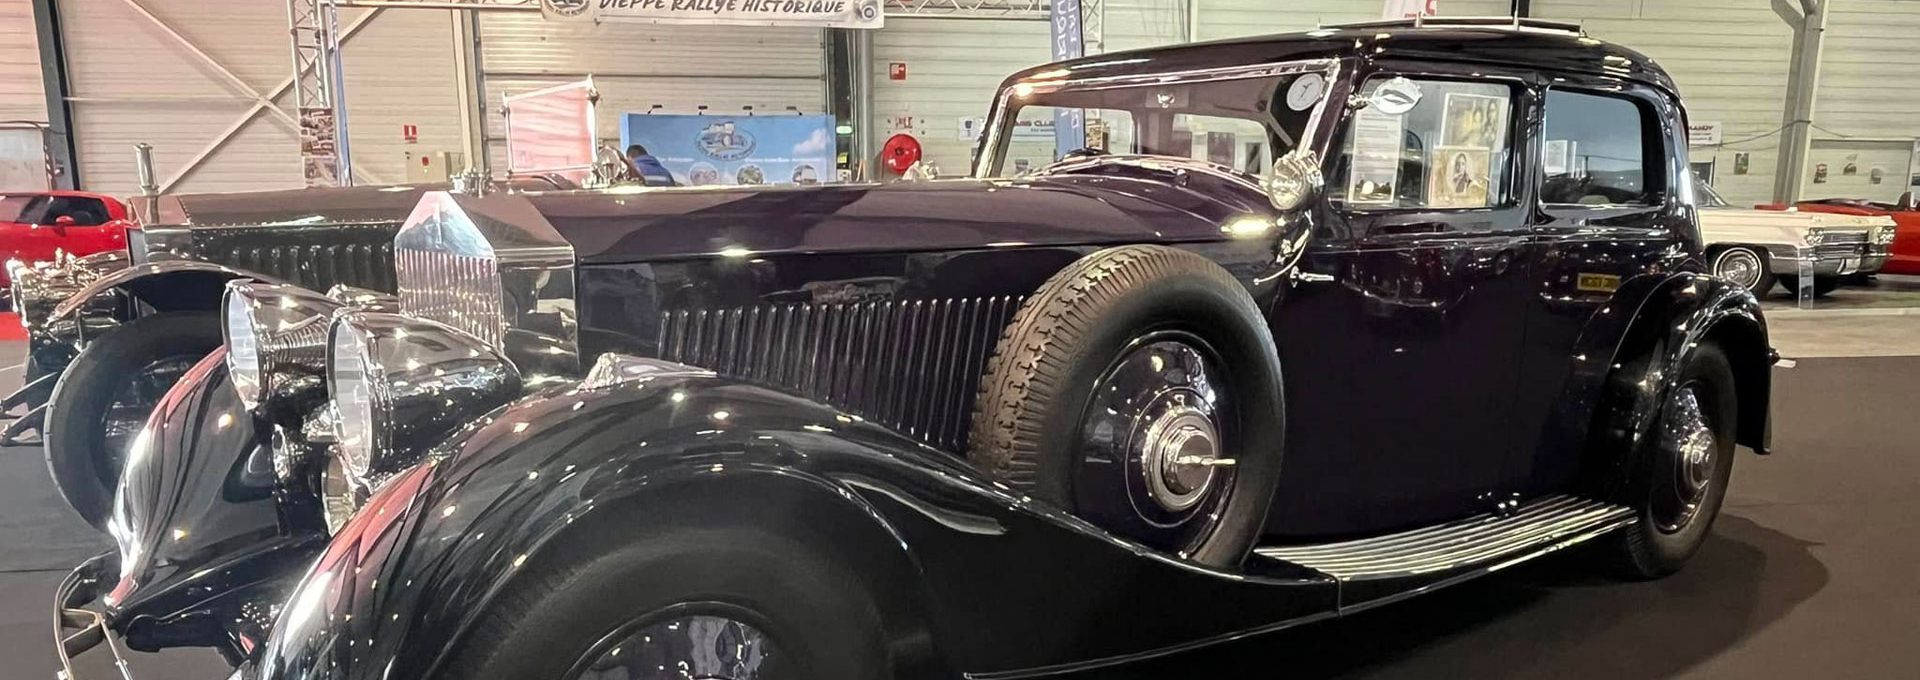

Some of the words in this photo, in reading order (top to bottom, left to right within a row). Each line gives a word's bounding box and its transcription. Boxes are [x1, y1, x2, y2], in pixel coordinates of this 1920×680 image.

[600, 0, 665, 9] DIEPPE
[671, 0, 736, 14] RALLYE
[742, 0, 845, 13] HISTORIQUE
